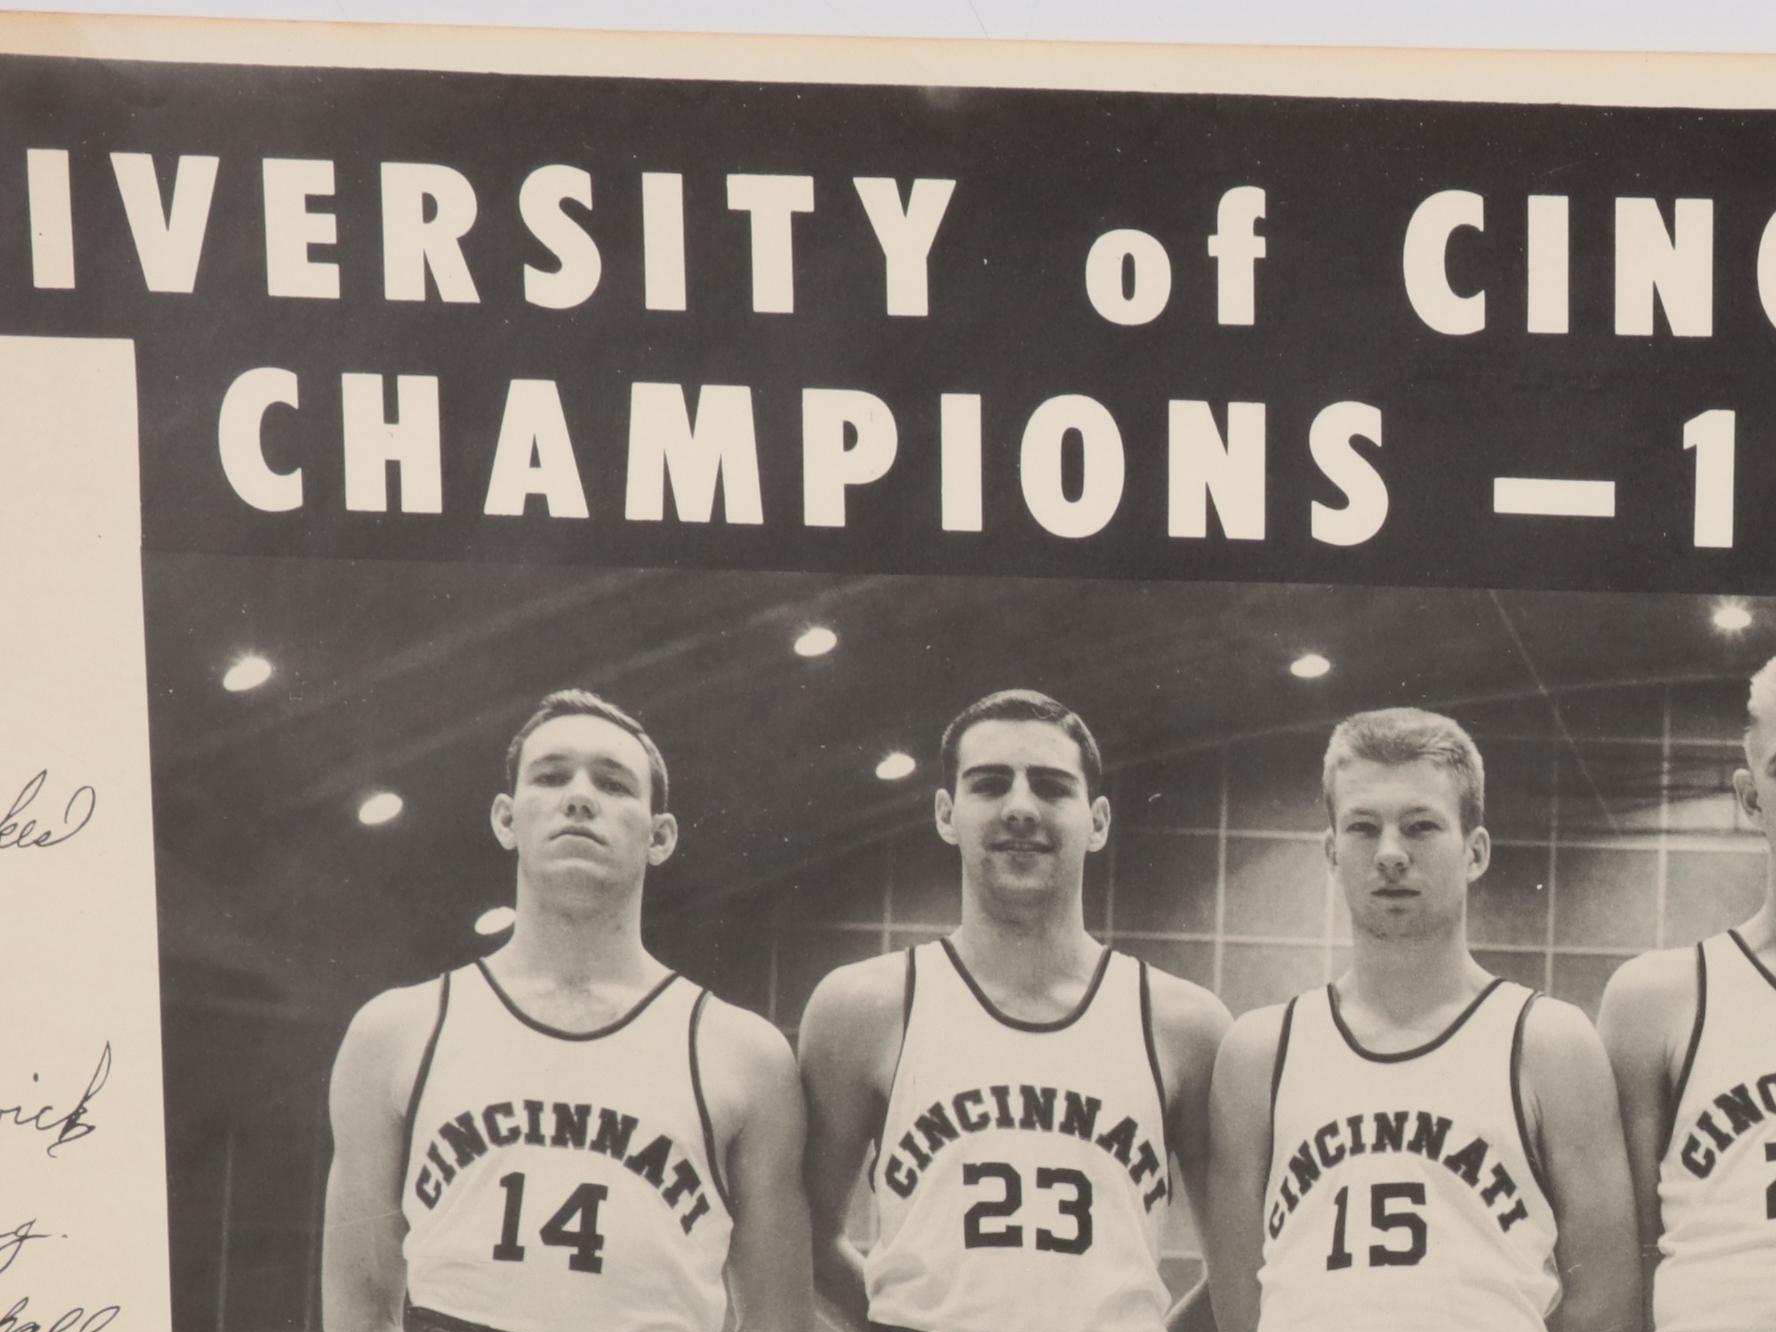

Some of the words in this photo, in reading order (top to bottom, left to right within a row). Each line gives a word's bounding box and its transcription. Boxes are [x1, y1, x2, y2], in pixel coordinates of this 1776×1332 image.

[27, 149, 956, 316] IVERSITY
[1086, 186, 1266, 325] of
[218, 367, 1388, 546] CHAMPIONS
[414, 1099, 711, 1235] CINCINNATI
[885, 1085, 1167, 1215] CINCINNATI
[963, 1162, 1092, 1255] 23
[1267, 1111, 1528, 1242] CINCINNATI
[493, 1172, 608, 1274] 14
[1327, 1182, 1427, 1270] 15
